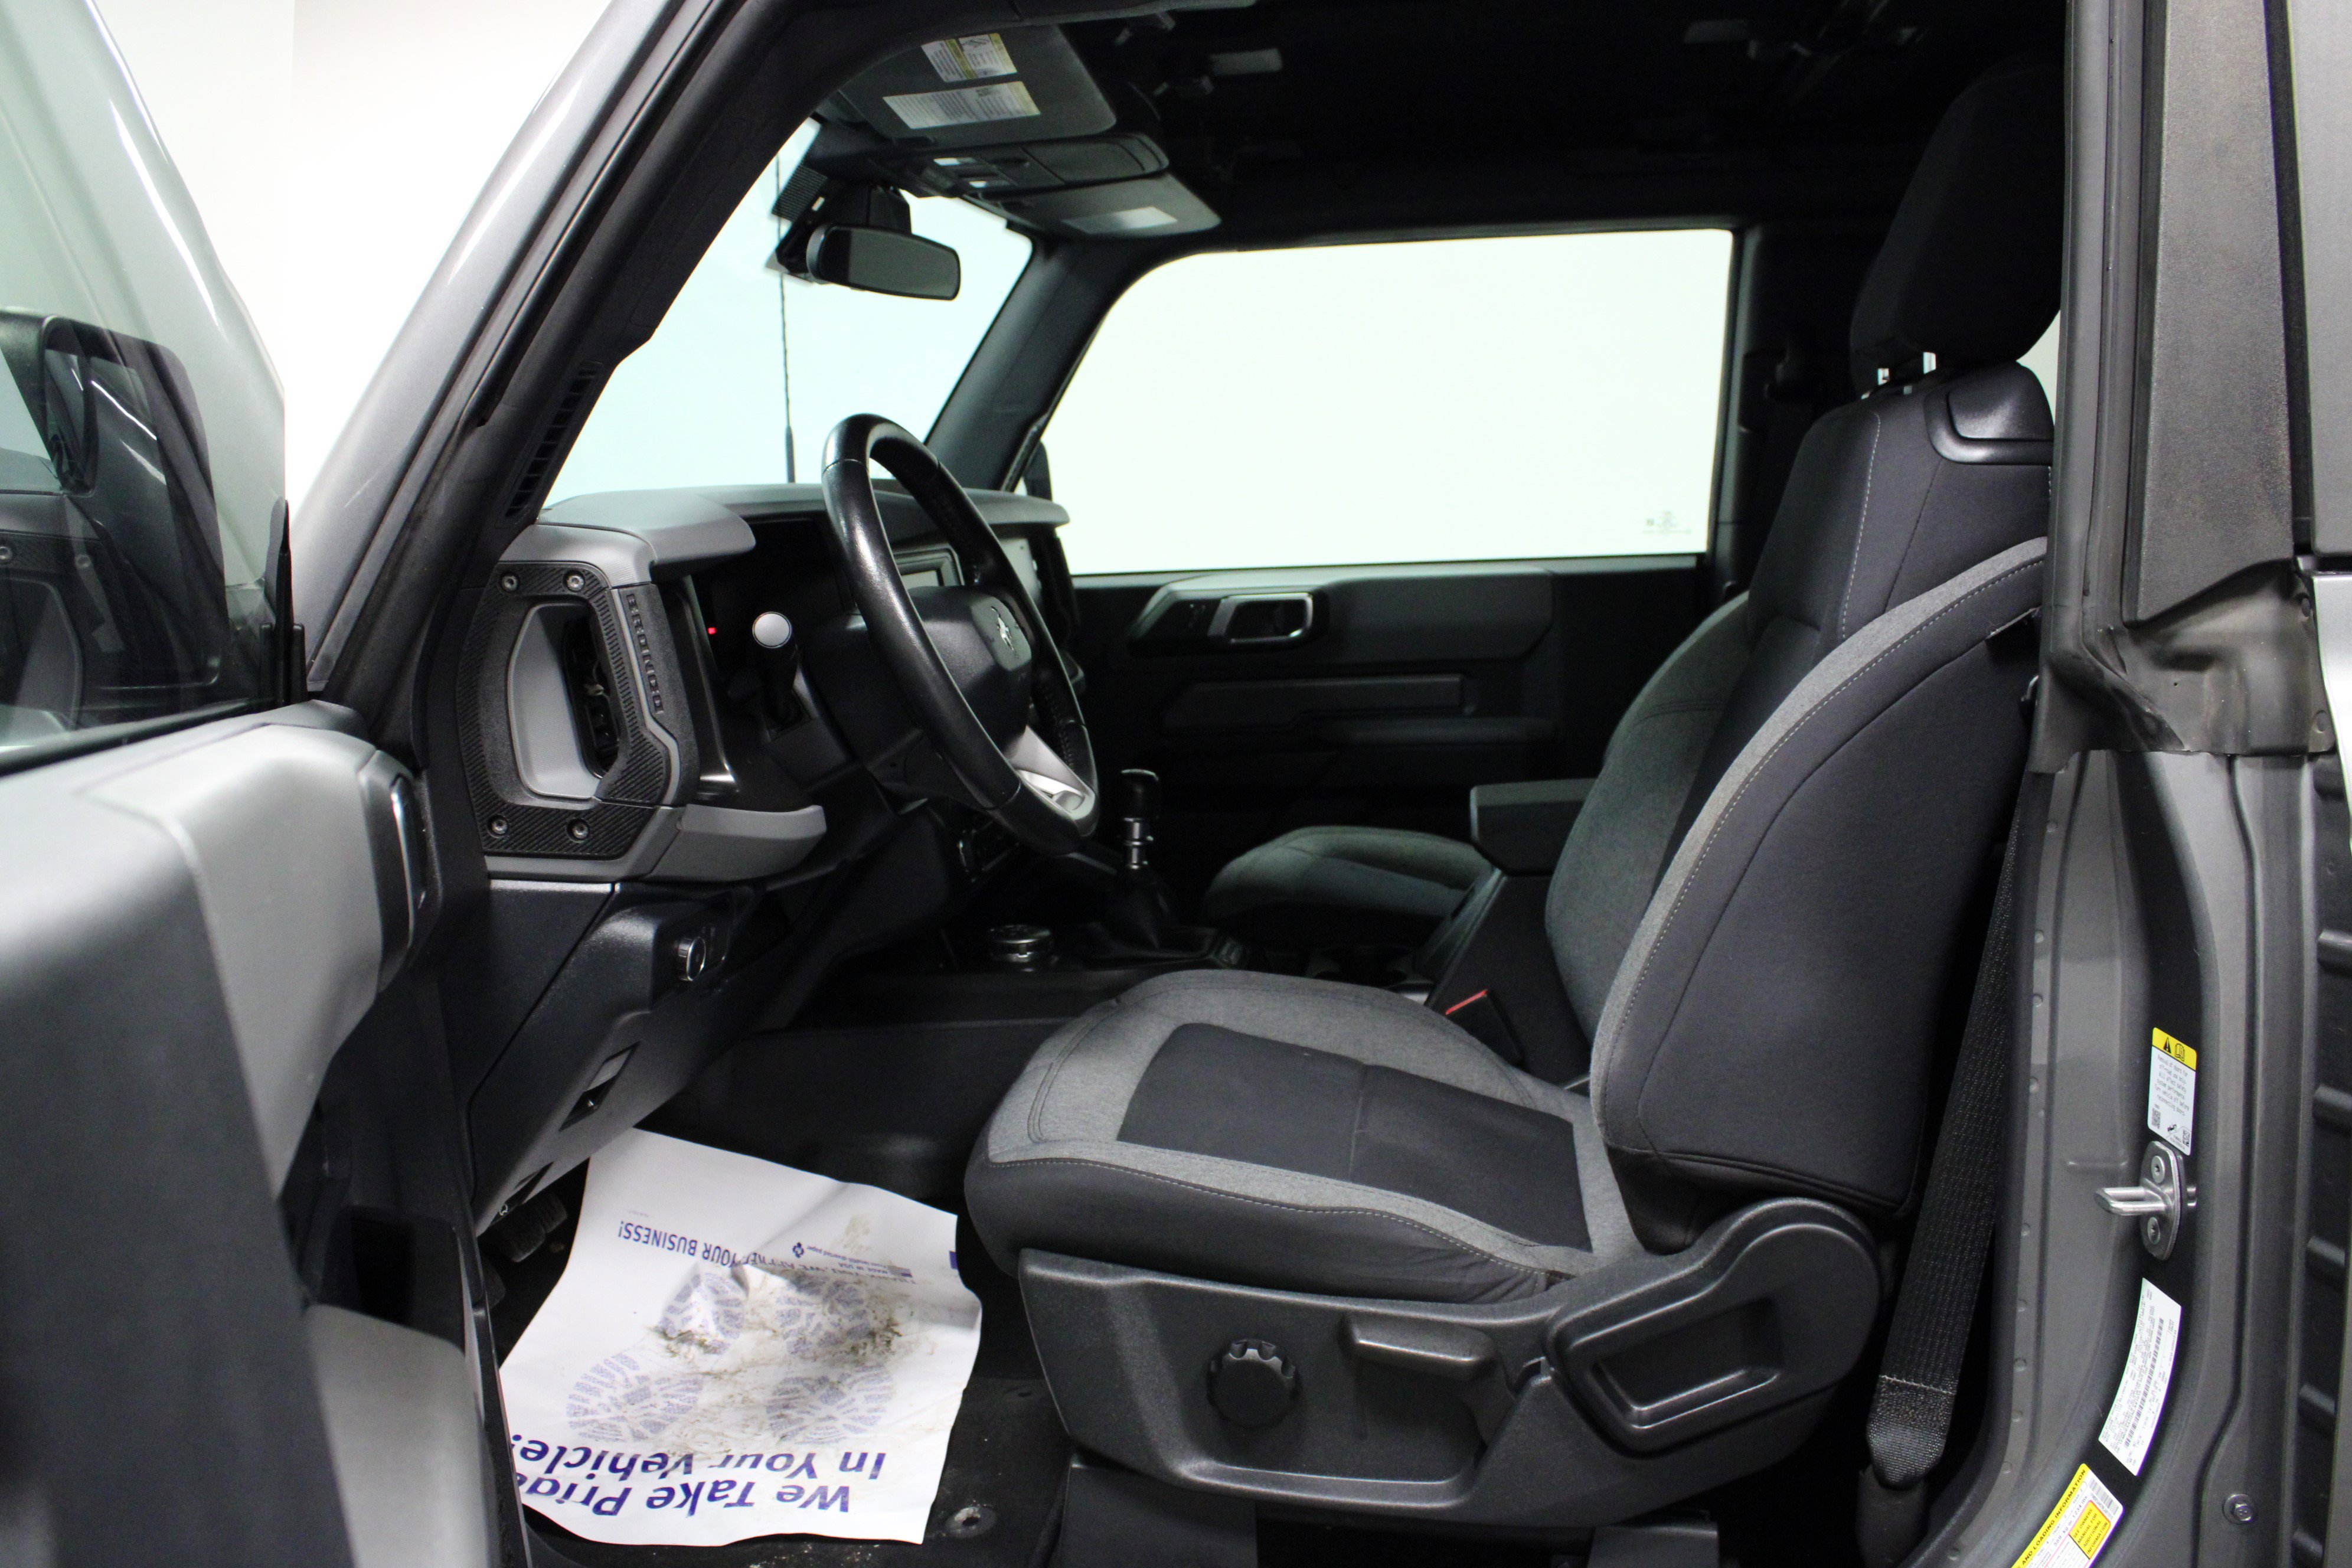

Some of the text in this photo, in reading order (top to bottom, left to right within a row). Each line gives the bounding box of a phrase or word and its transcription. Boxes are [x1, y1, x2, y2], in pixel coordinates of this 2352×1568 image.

[627, 593, 664, 714] BRONCO
[618, 1220, 738, 1268] YOUR BUSINESS!
[707, 1452, 818, 1479] Your
[839, 1451, 887, 1480] In
[646, 1479, 756, 1518] Take
[776, 1484, 850, 1513] We
[2021, 1550, 2033, 1566] AND
[2033, 1520, 2055, 1550] LOADING
[2054, 1469, 2086, 1519] INFORMATION
[2087, 1522, 2108, 1555] INFORMATION
